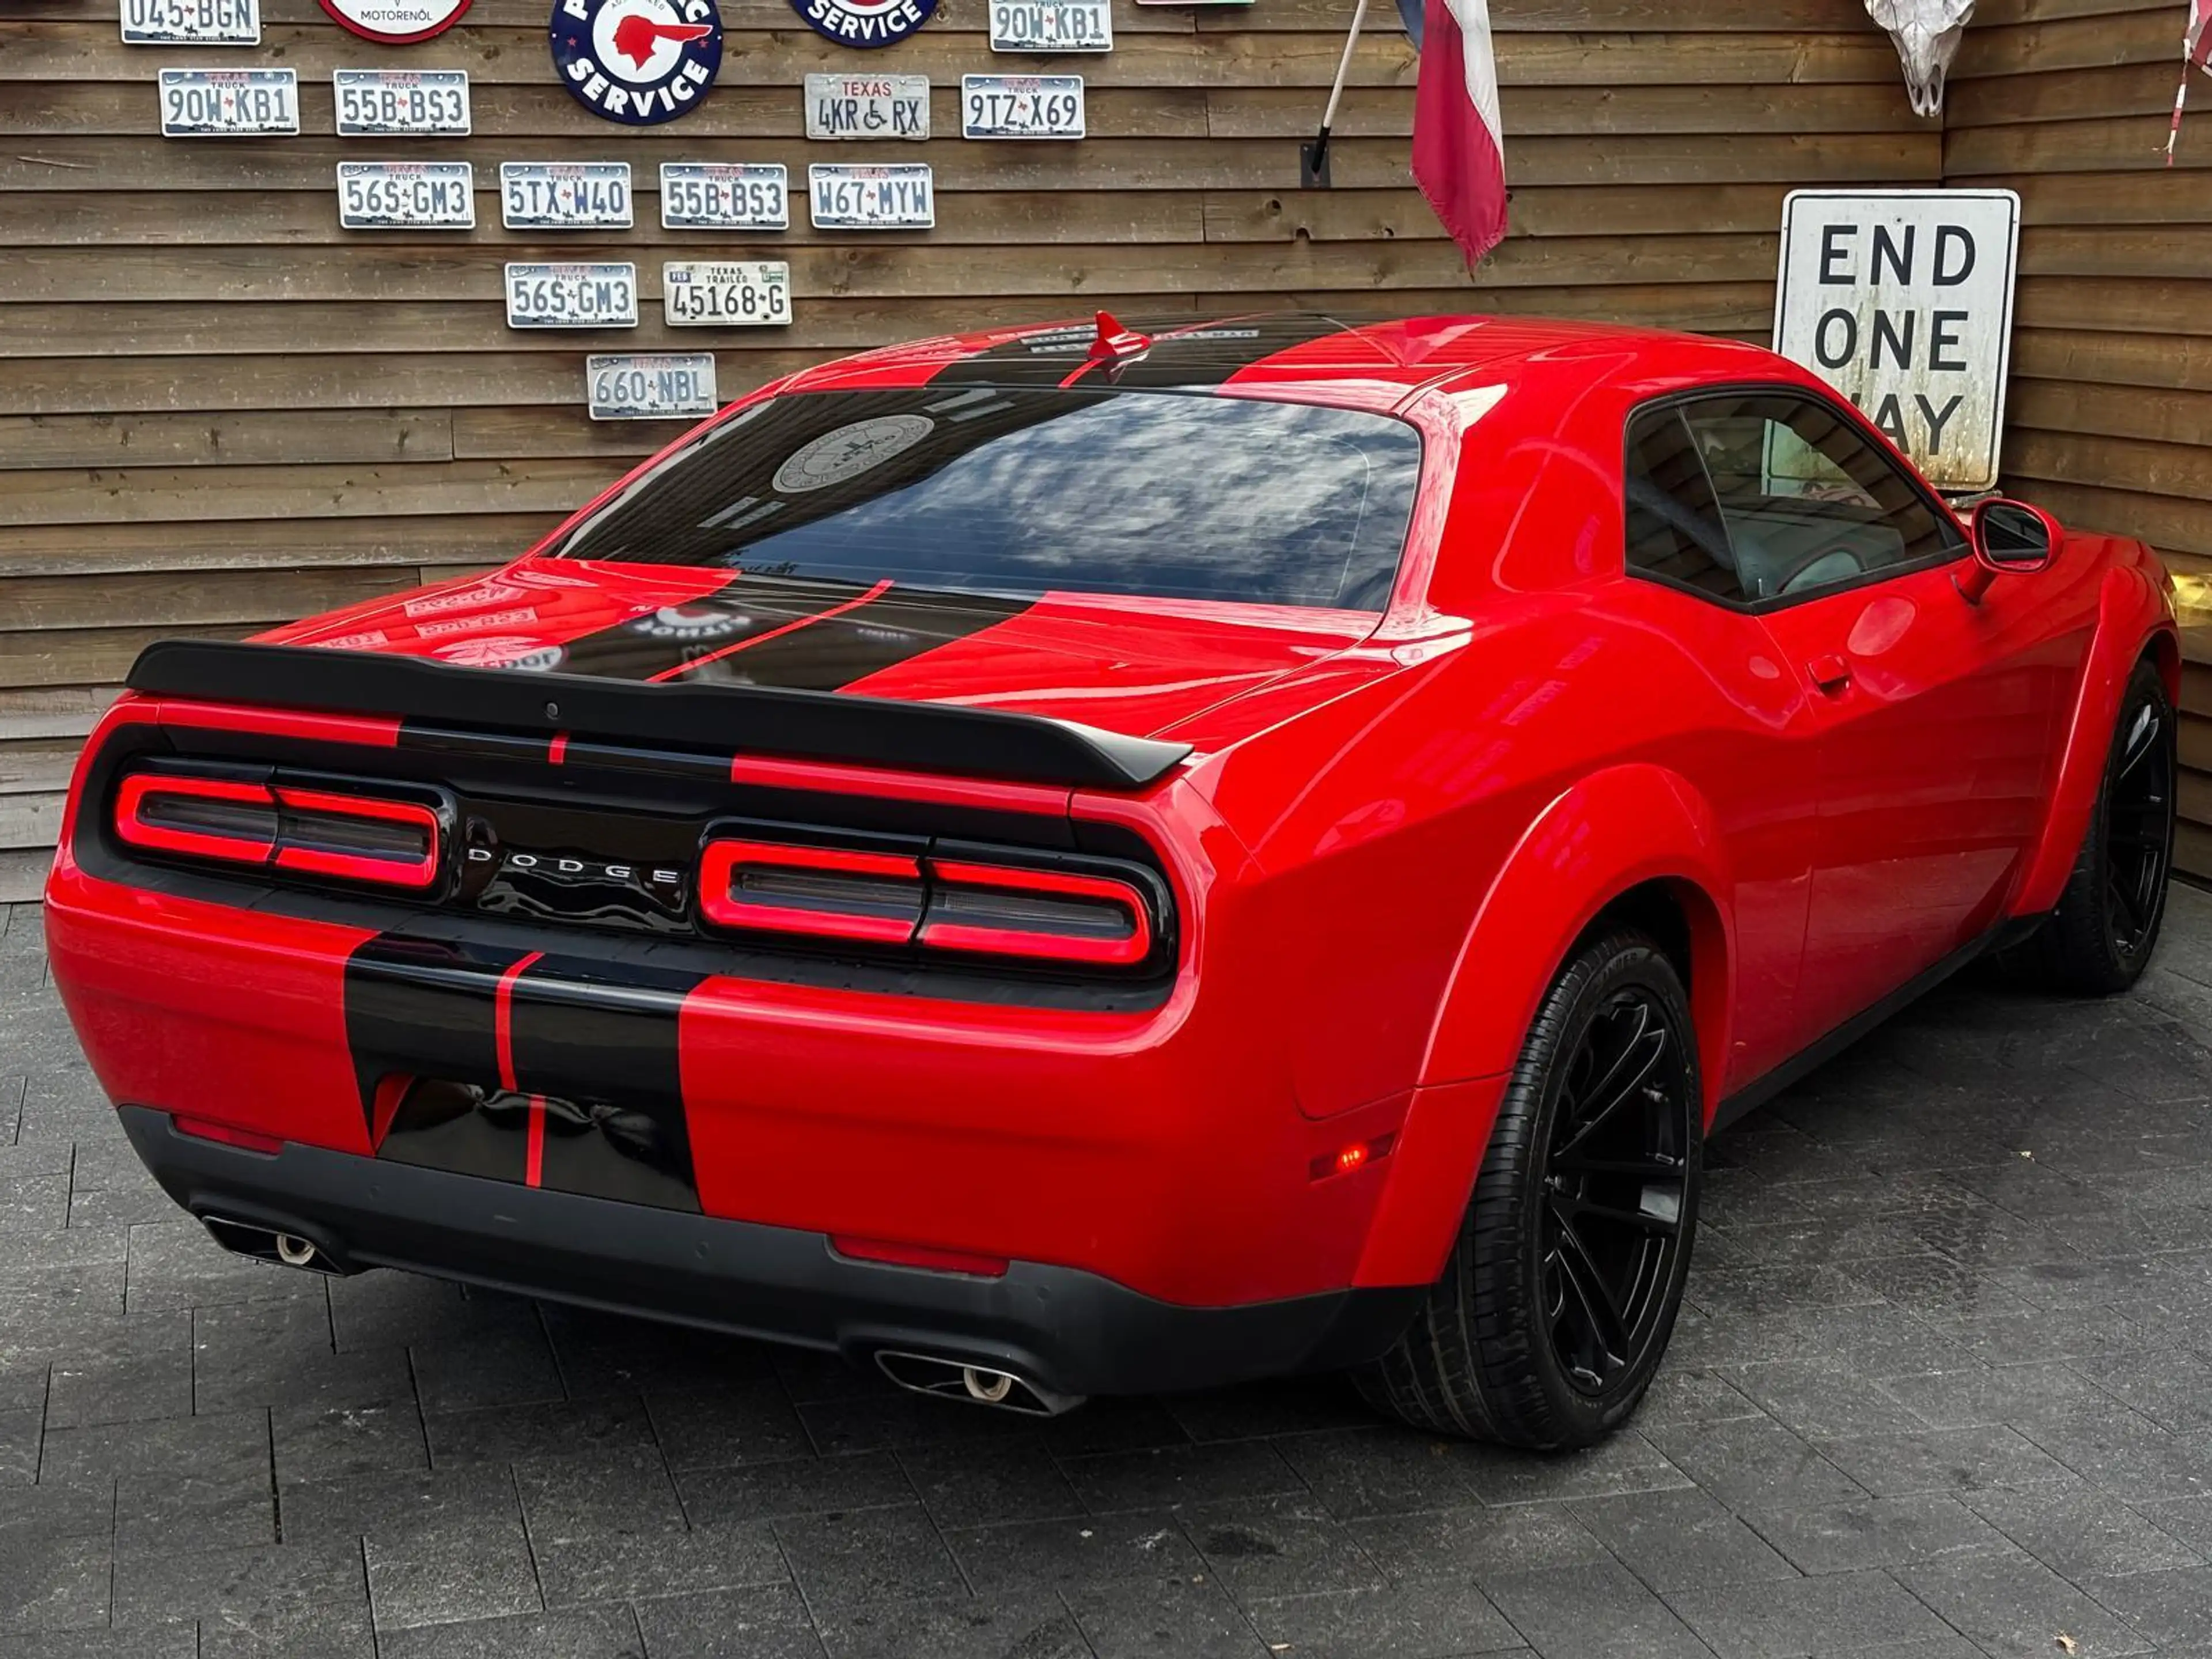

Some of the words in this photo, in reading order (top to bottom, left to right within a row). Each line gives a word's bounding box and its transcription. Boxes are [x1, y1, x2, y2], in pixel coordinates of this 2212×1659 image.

[808, 0, 922, 39] SERVICE
[1055, 8, 1104, 39] KB1
[567, 58, 709, 116] SERVICE
[842, 81, 892, 97] TEXAS
[235, 89, 290, 122] KB1
[343, 89, 397, 122] 55B
[410, 90, 463, 122] BS3
[819, 99, 858, 130] 4KR
[893, 100, 920, 131] RX
[971, 95, 1017, 125] 9TZ
[1031, 95, 1077, 126] X69
[347, 180, 399, 213] 56S
[414, 181, 465, 214] GM3
[509, 181, 560, 213] 5TX
[669, 181, 720, 215] 55B
[732, 183, 782, 216] BS3
[818, 181, 865, 214] W67
[878, 181, 927, 214] MYW
[1819, 225, 1976, 286] END
[706, 275, 748, 283] TRAILER
[514, 280, 565, 312] 56S
[578, 282, 629, 313] GM3
[674, 285, 756, 316] 45168
[1815, 308, 1968, 371] ONE
[657, 371, 709, 402] NBL
[1850, 393, 1964, 455] AY
[468, 849, 678, 883] DODGE
